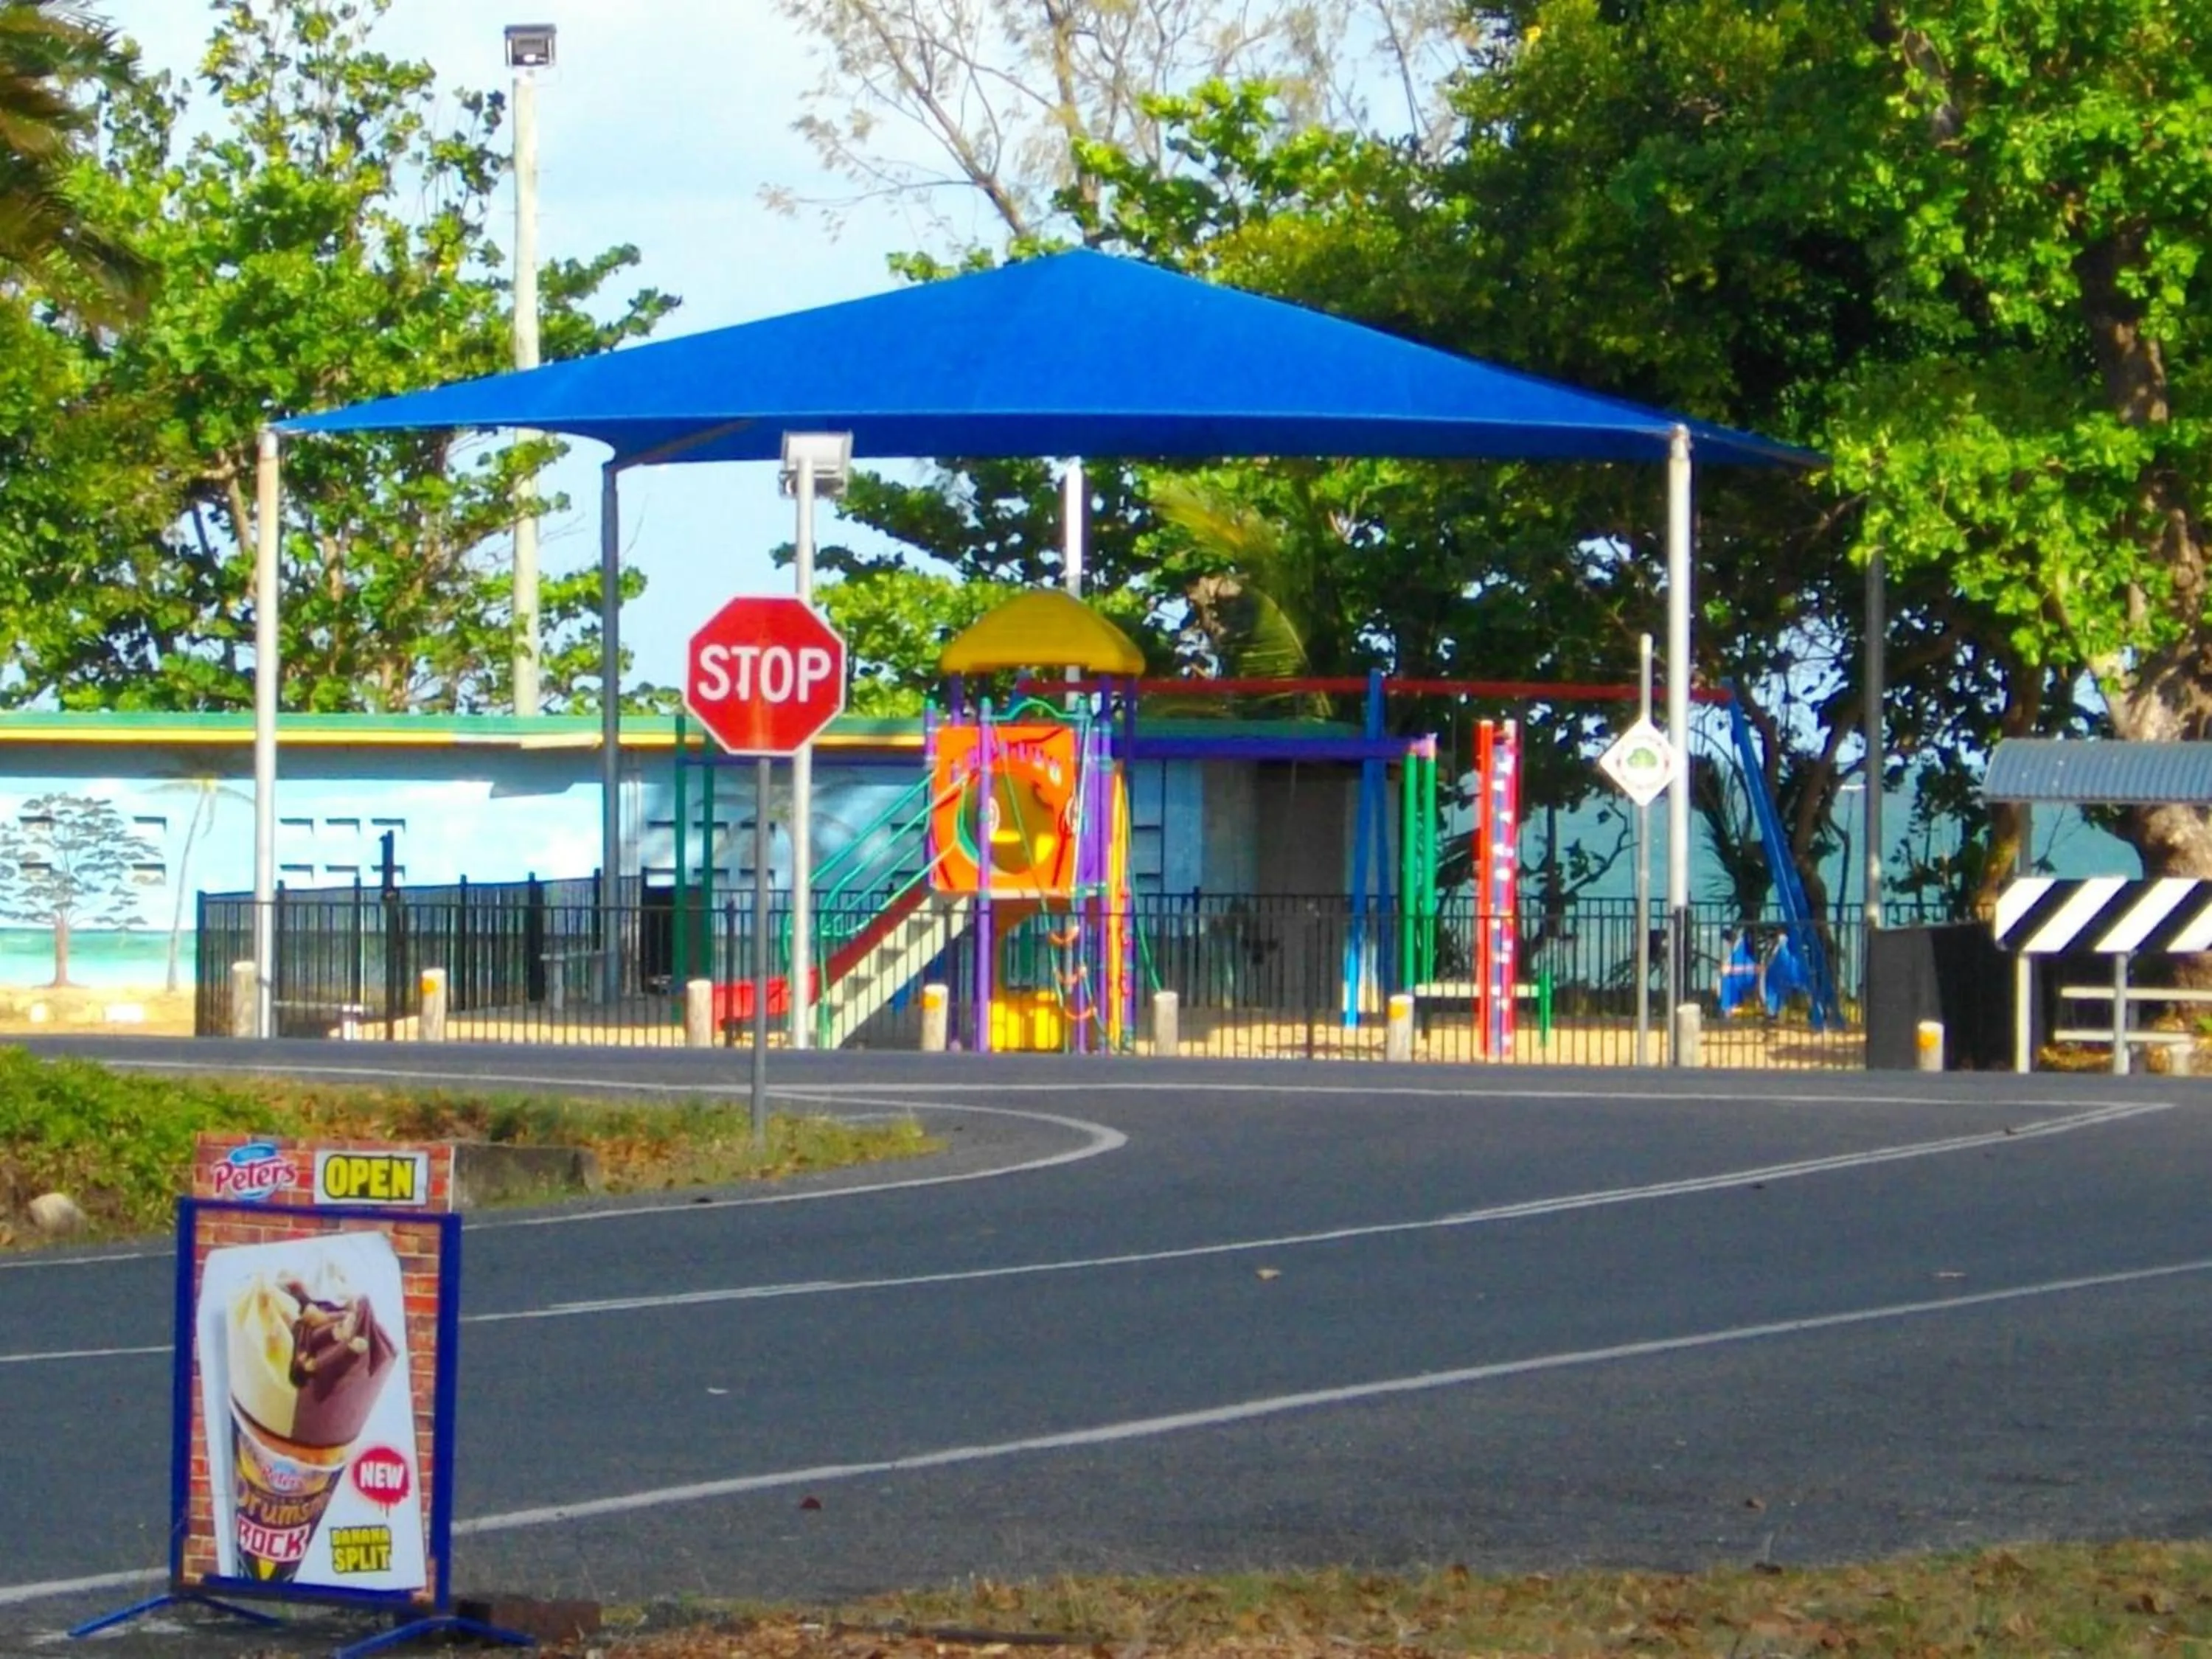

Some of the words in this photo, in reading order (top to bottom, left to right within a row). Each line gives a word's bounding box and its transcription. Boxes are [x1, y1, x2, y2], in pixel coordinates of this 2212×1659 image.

[698, 644, 832, 703] STOP
[212, 1158, 297, 1194] Peters
[324, 1155, 414, 1200] OPEN
[360, 1461, 404, 1489] NEW
[238, 1517, 309, 1559] ROCK
[332, 1545, 391, 1573] SPLIT
